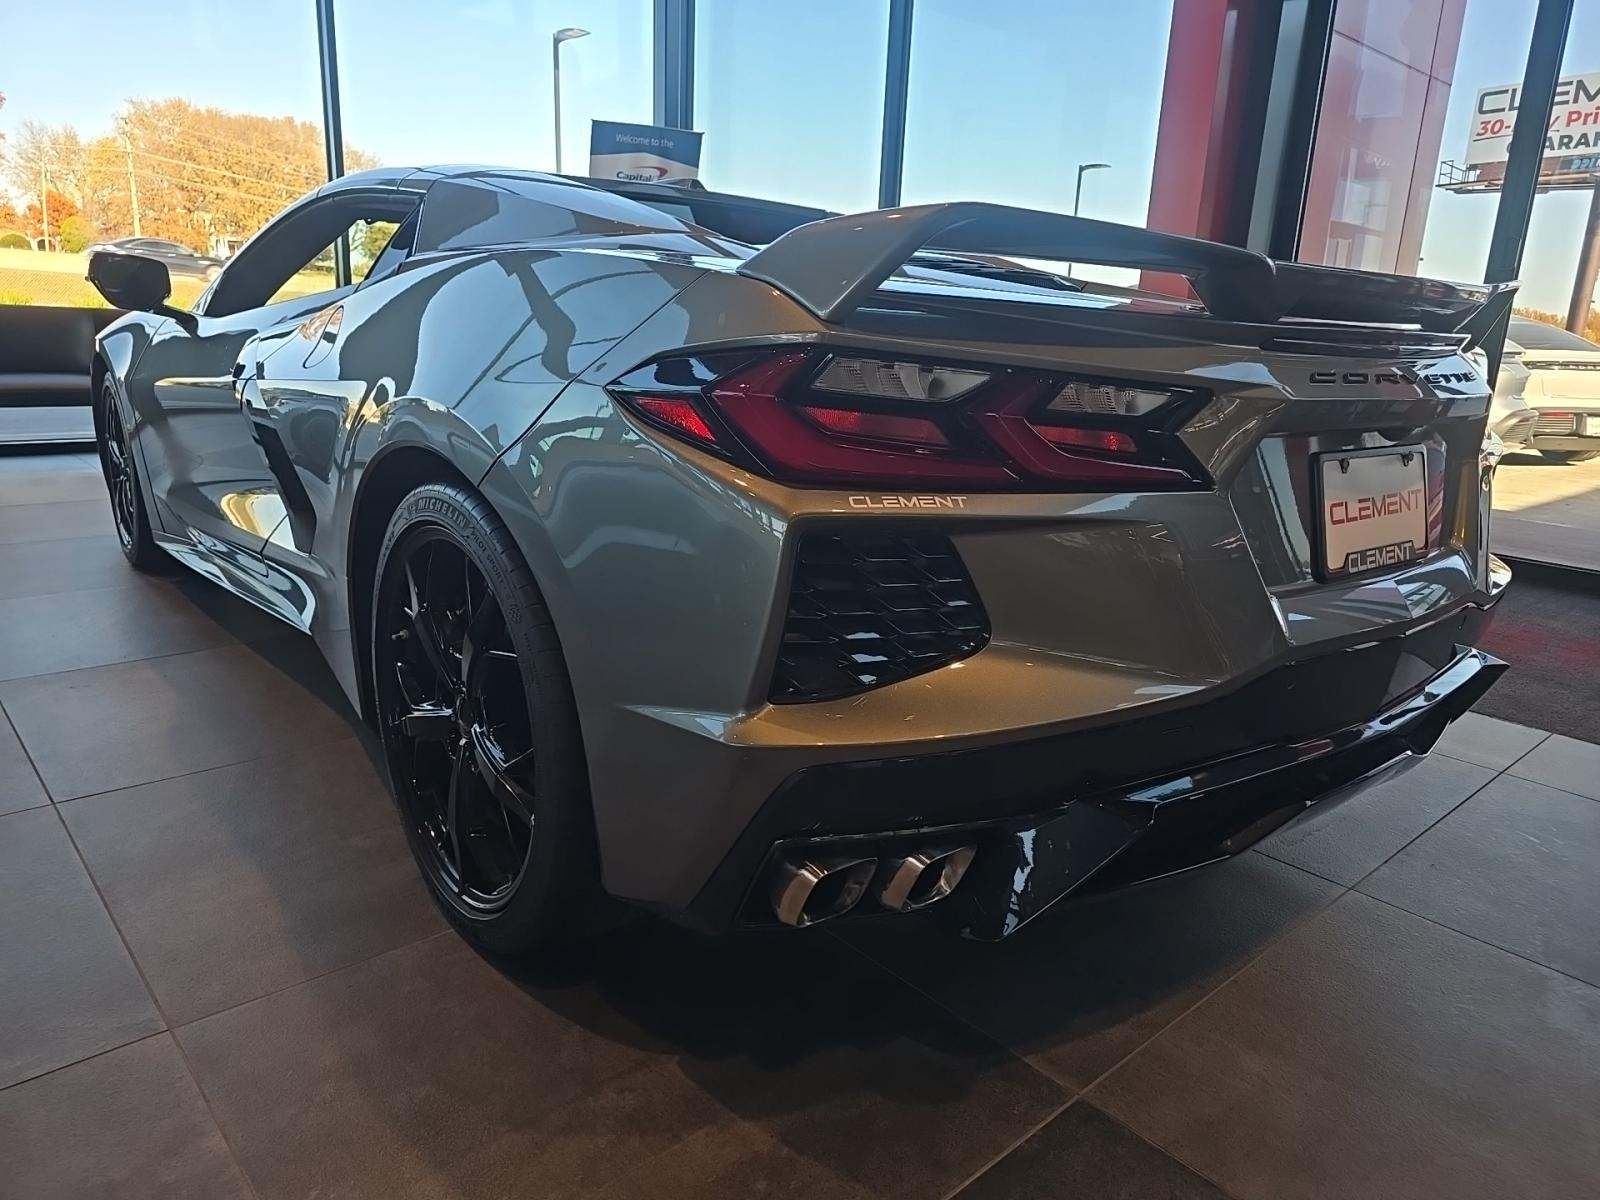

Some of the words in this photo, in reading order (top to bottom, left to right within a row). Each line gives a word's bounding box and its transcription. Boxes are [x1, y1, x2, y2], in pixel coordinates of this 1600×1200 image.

[616, 133, 649, 146] Welcome
[651, 138, 659, 146] to
[660, 138, 674, 149] the
[616, 170, 652, 182] Capital
[1309, 370, 1477, 385] CORVETTE
[848, 495, 967, 508] CLEMENT
[1329, 488, 1422, 526] CLEMENT
[417, 496, 467, 528] MICHELIN
[1348, 541, 1413, 574] CLEMENT
